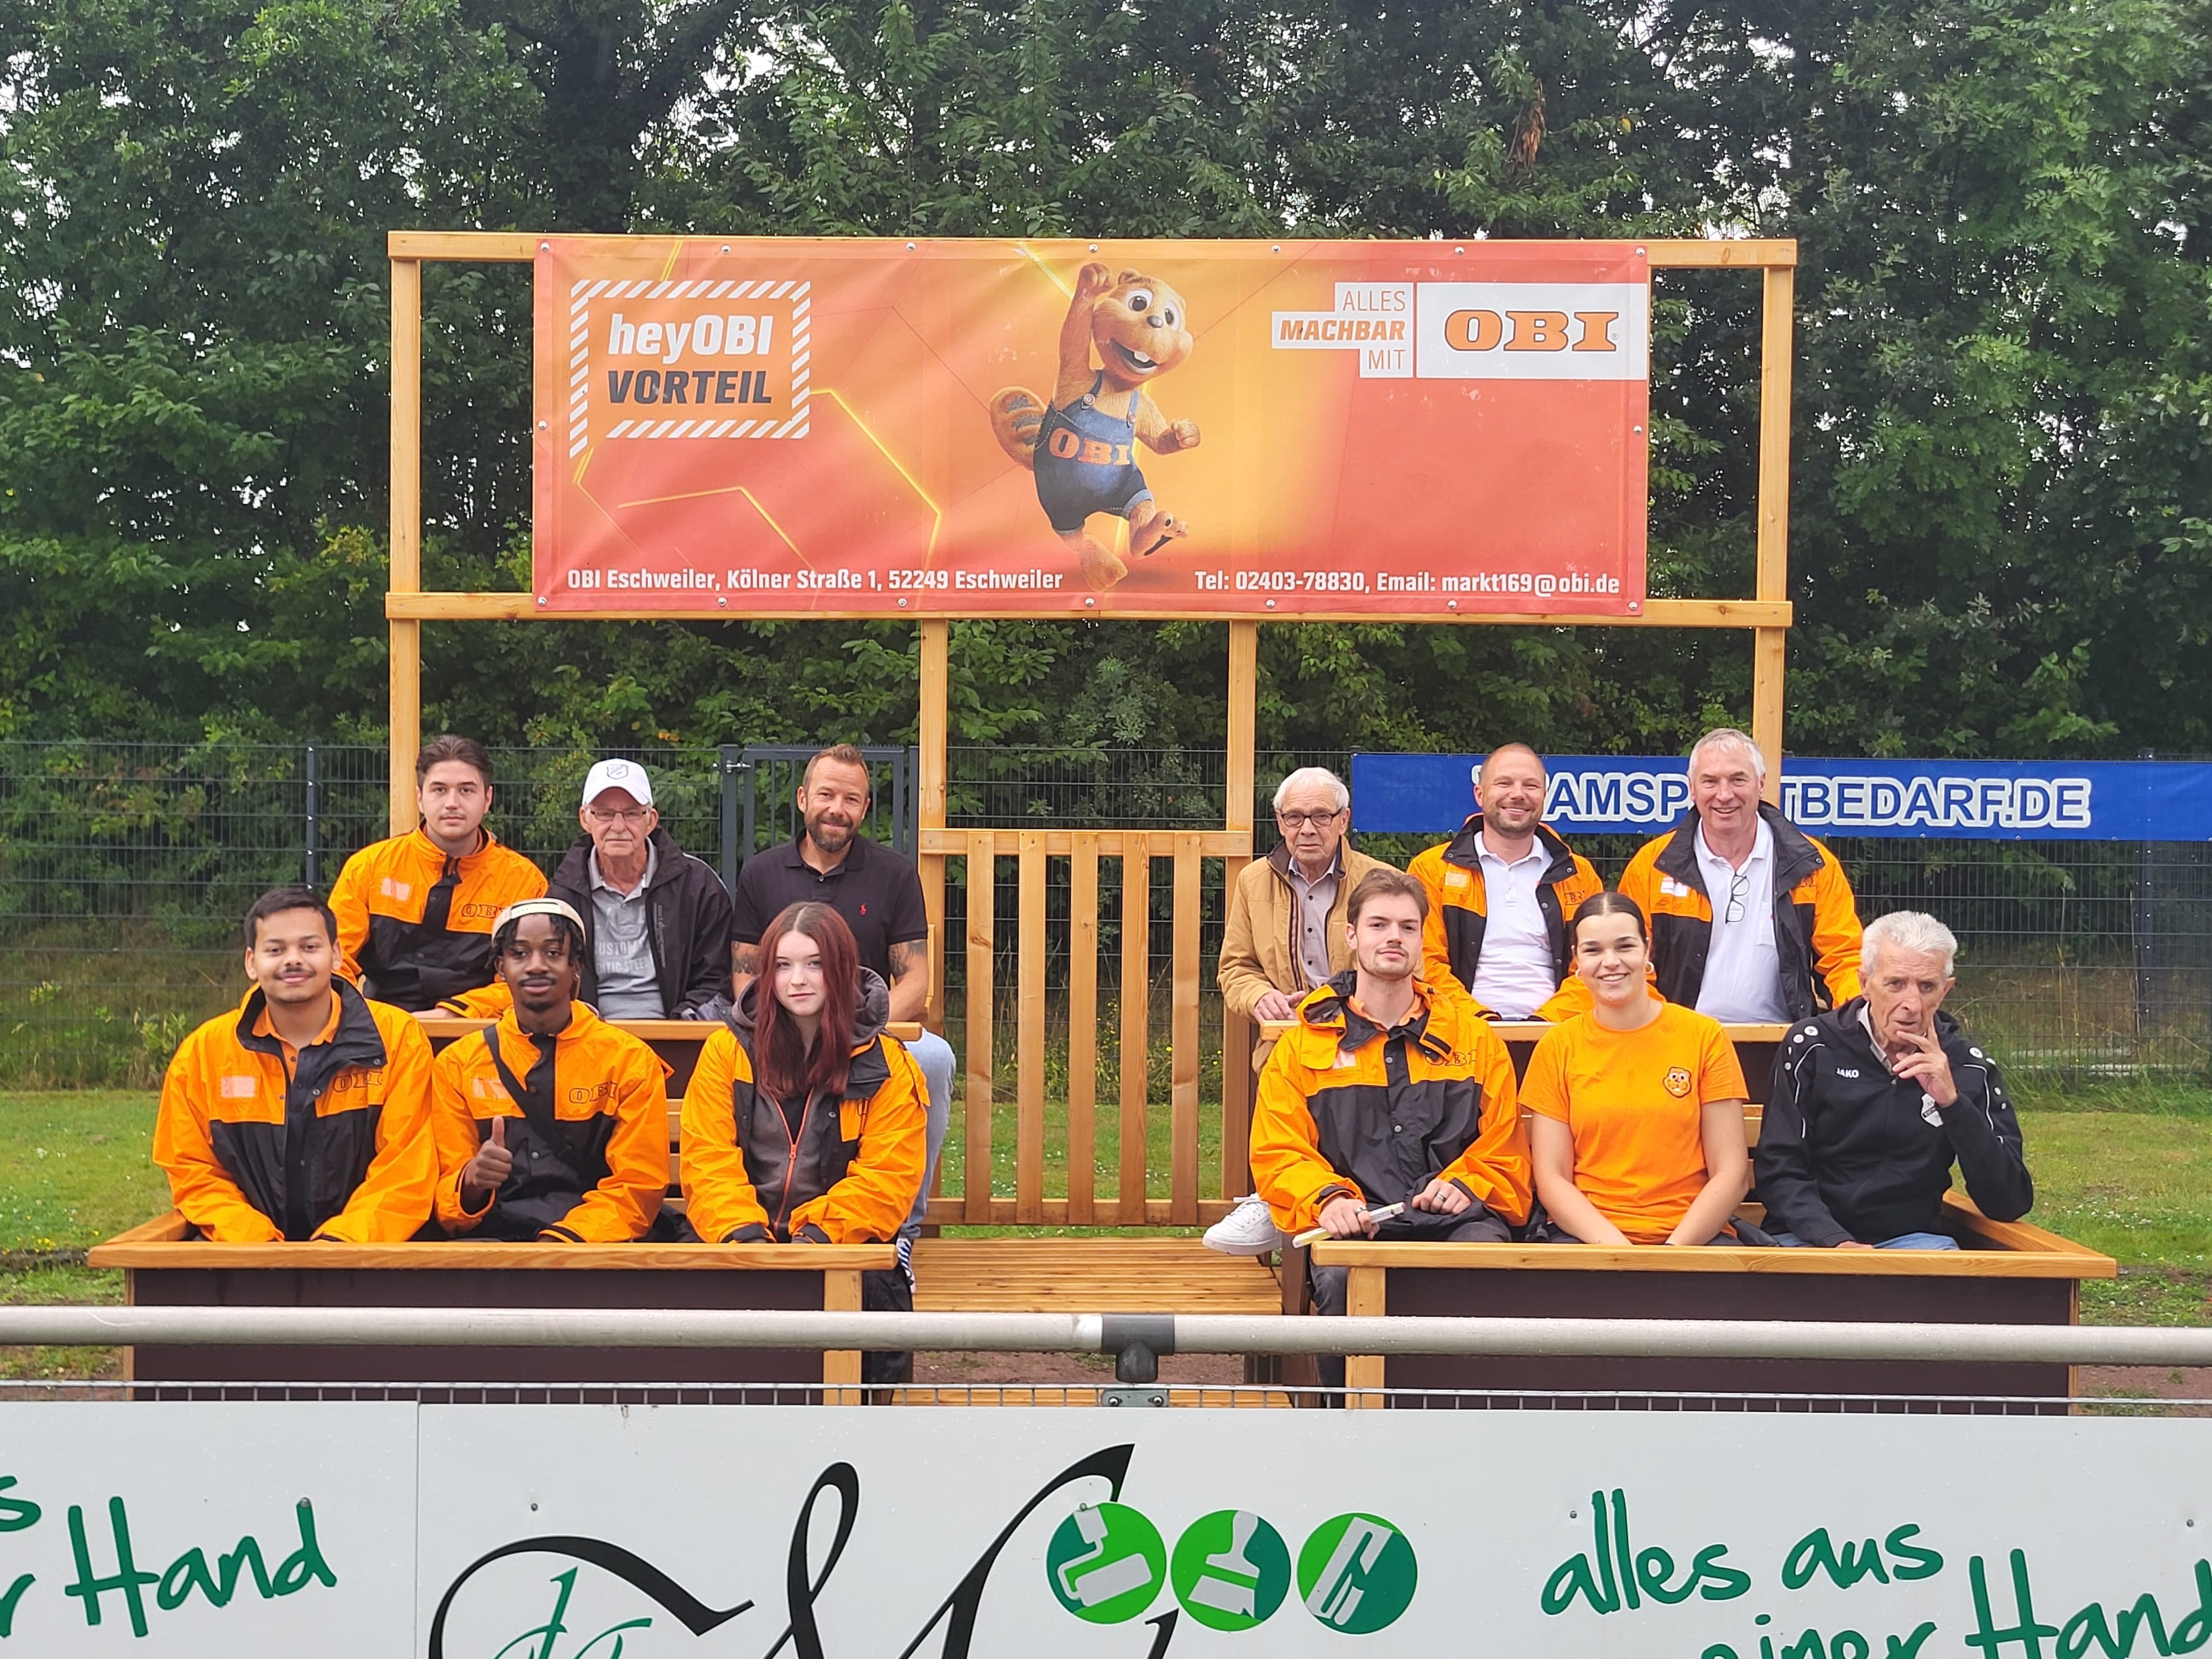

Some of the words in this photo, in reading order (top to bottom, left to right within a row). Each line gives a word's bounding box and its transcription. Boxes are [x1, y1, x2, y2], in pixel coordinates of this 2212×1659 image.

[1342, 290, 1406, 312] ALLES
[608, 313, 774, 364] heyOBI
[1279, 320, 1405, 341] MACHBAR
[1444, 309, 1619, 352] OBI
[1368, 349, 1405, 370] MIT
[608, 369, 773, 405] VORTEIL
[1048, 427, 1131, 466] OBI
[567, 569, 601, 588] OBI
[607, 568, 721, 592] Eschweiler,
[727, 568, 791, 588] Kölner
[797, 568, 862, 588] Straße
[868, 570, 882, 592] 1,
[889, 570, 948, 589] 52249
[956, 568, 1062, 589] Eschweiler
[1194, 570, 1230, 590] Tel:
[1235, 571, 1370, 594] 02403-78830,
[1377, 572, 1436, 591] Email:
[1442, 572, 1620, 598] markt169@obi.de
[1836, 1067, 1860, 1078] JAKO
[64, 1496, 337, 1638] Hand
[1541, 1489, 1751, 1615] alles
[1782, 1524, 1943, 1589] aus
